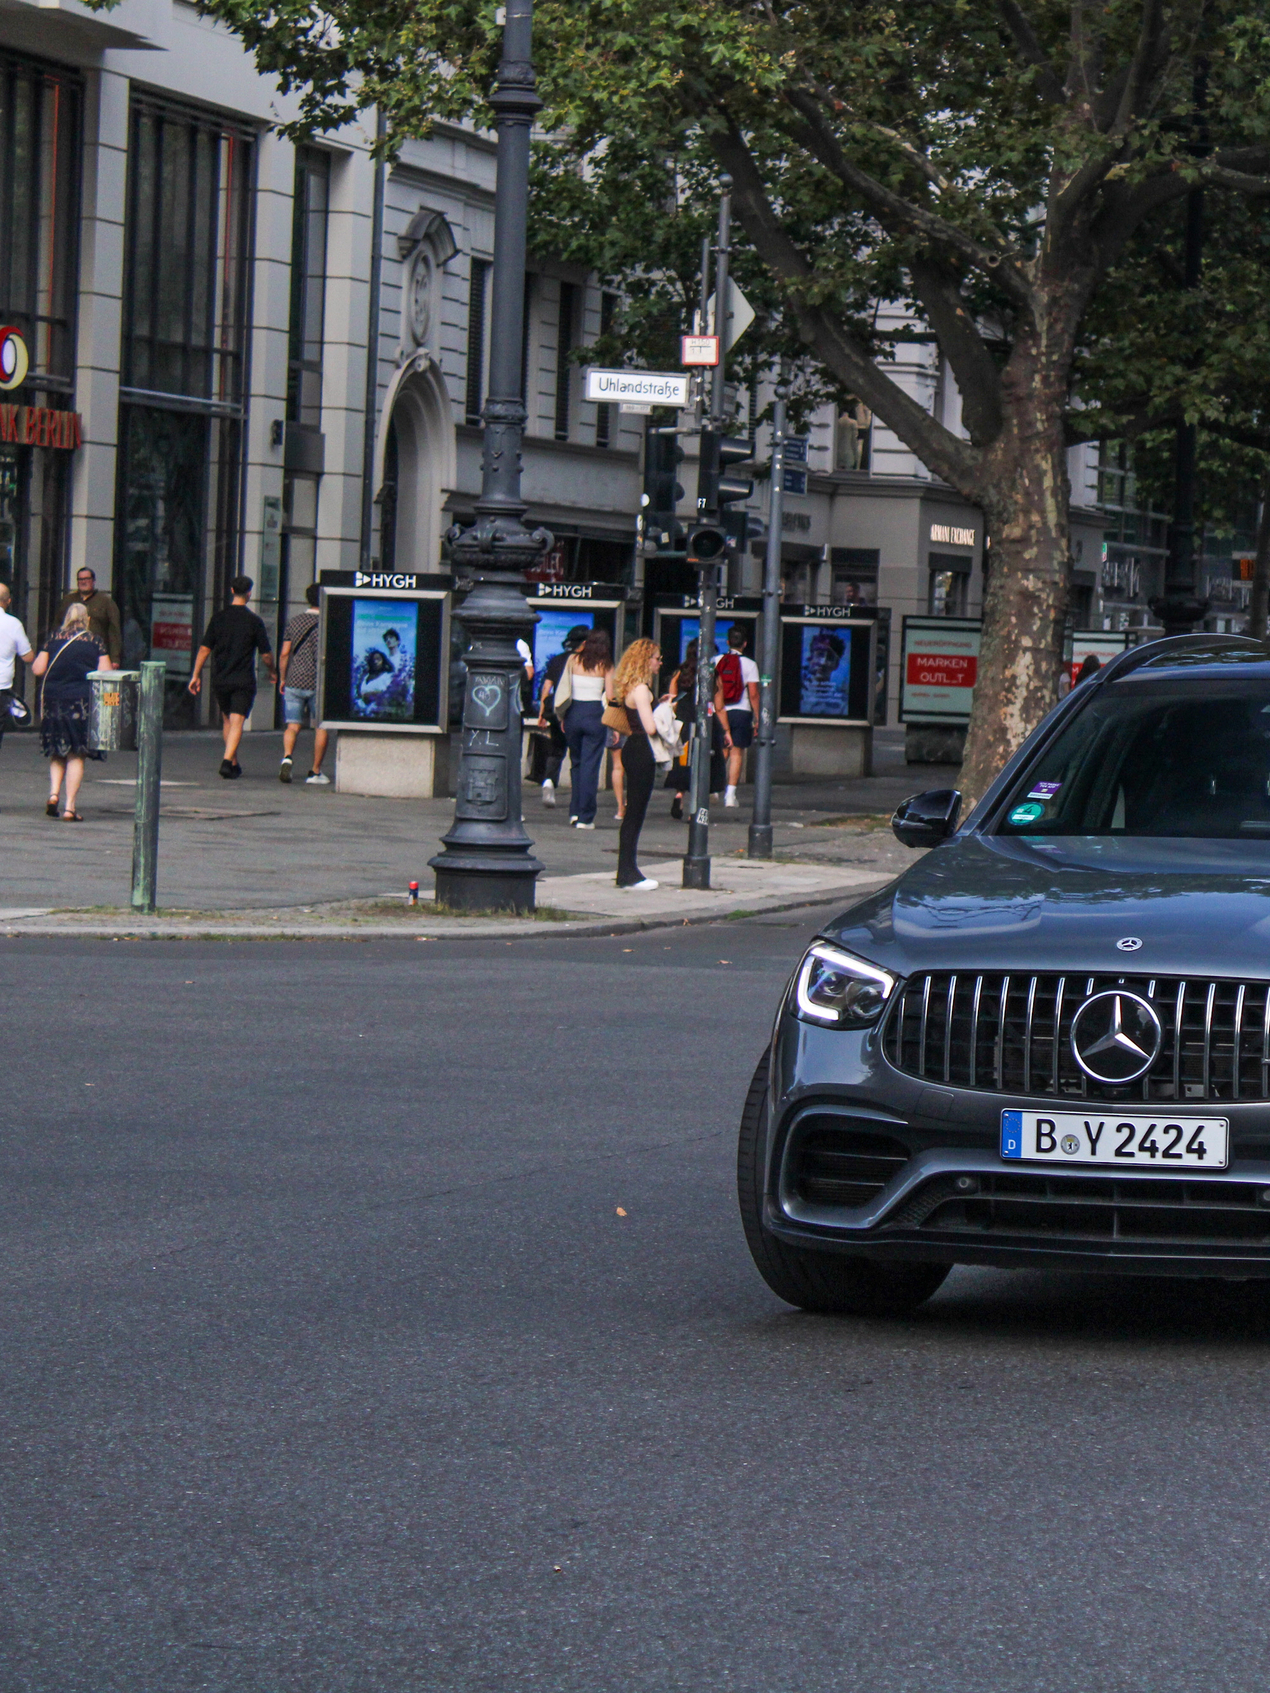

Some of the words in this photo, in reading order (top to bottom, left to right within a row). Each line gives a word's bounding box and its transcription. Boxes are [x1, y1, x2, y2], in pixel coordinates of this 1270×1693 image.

[598, 377, 680, 399] Uhlandstraße
[26, 406, 82, 450] BERLIN
[697, 497, 707, 509] F7
[930, 523, 950, 543] ARMANI
[950, 526, 976, 547] EXCHANGE
[372, 573, 417, 589] HYGH
[552, 584, 592, 598] HYGH
[816, 606, 851, 618] HYGH
[917, 656, 968, 669] MARKEN
[1036, 1118, 1057, 1153] B
[1084, 1120, 1105, 1156] Y
[1114, 1122, 1207, 1160] 2424
